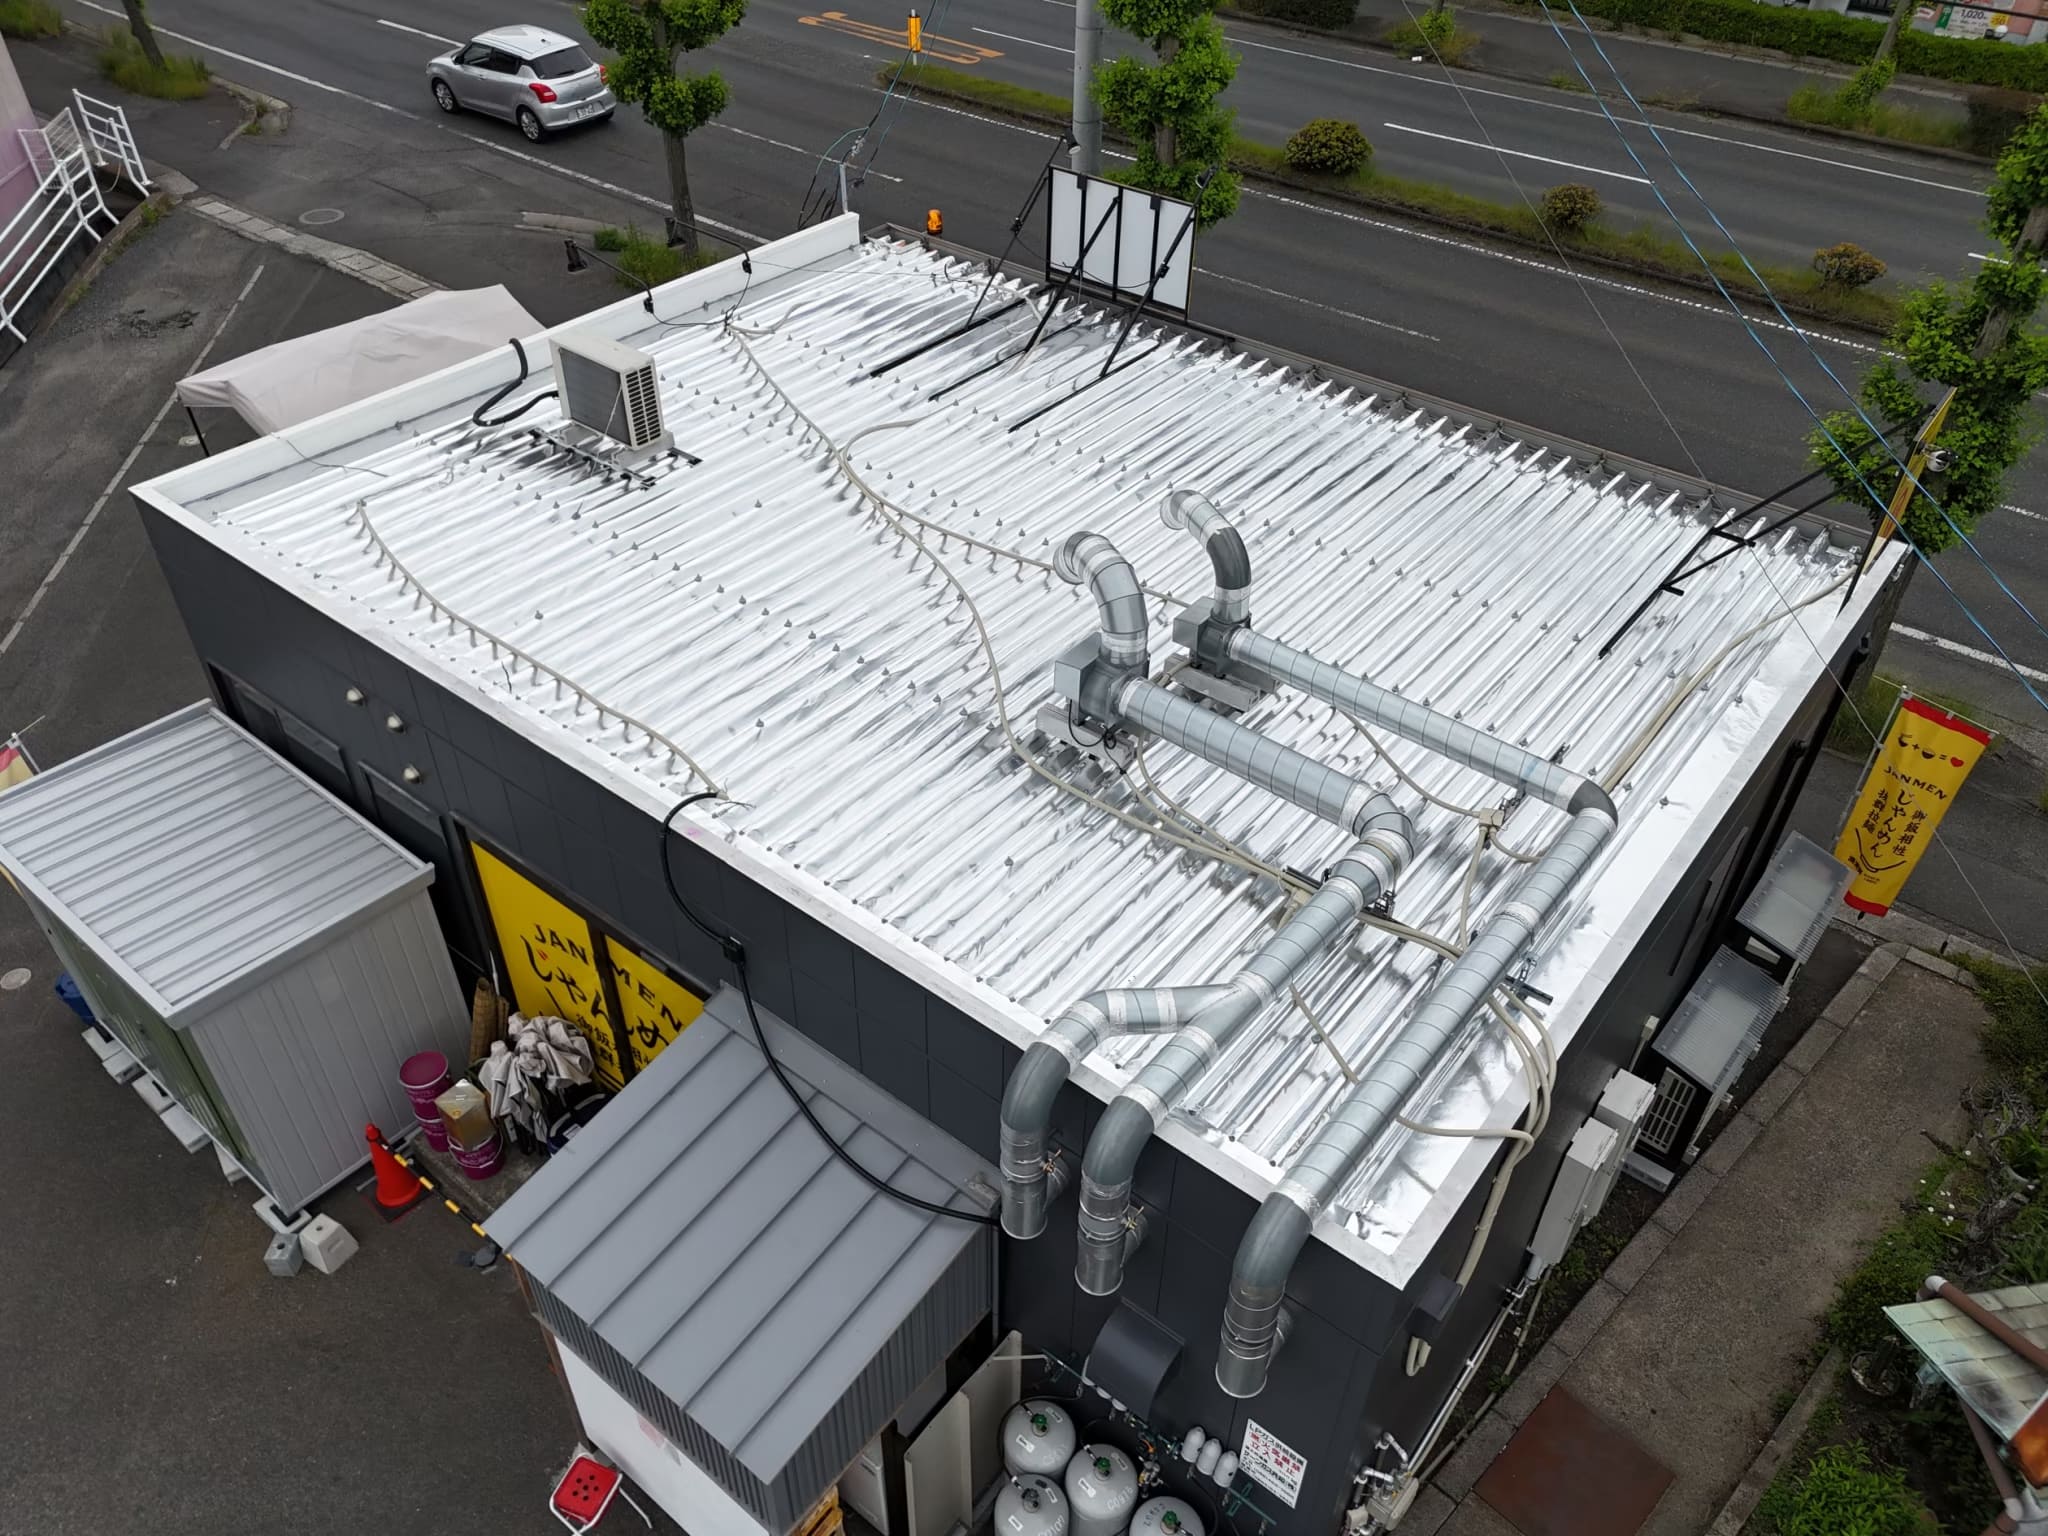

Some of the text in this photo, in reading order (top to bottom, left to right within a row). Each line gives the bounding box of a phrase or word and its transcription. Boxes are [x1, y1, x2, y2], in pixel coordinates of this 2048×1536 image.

[1884, 766, 1948, 800] JANMEN
[1892, 809, 1928, 857] 御飯相性
[534, 923, 589, 965] JAN
